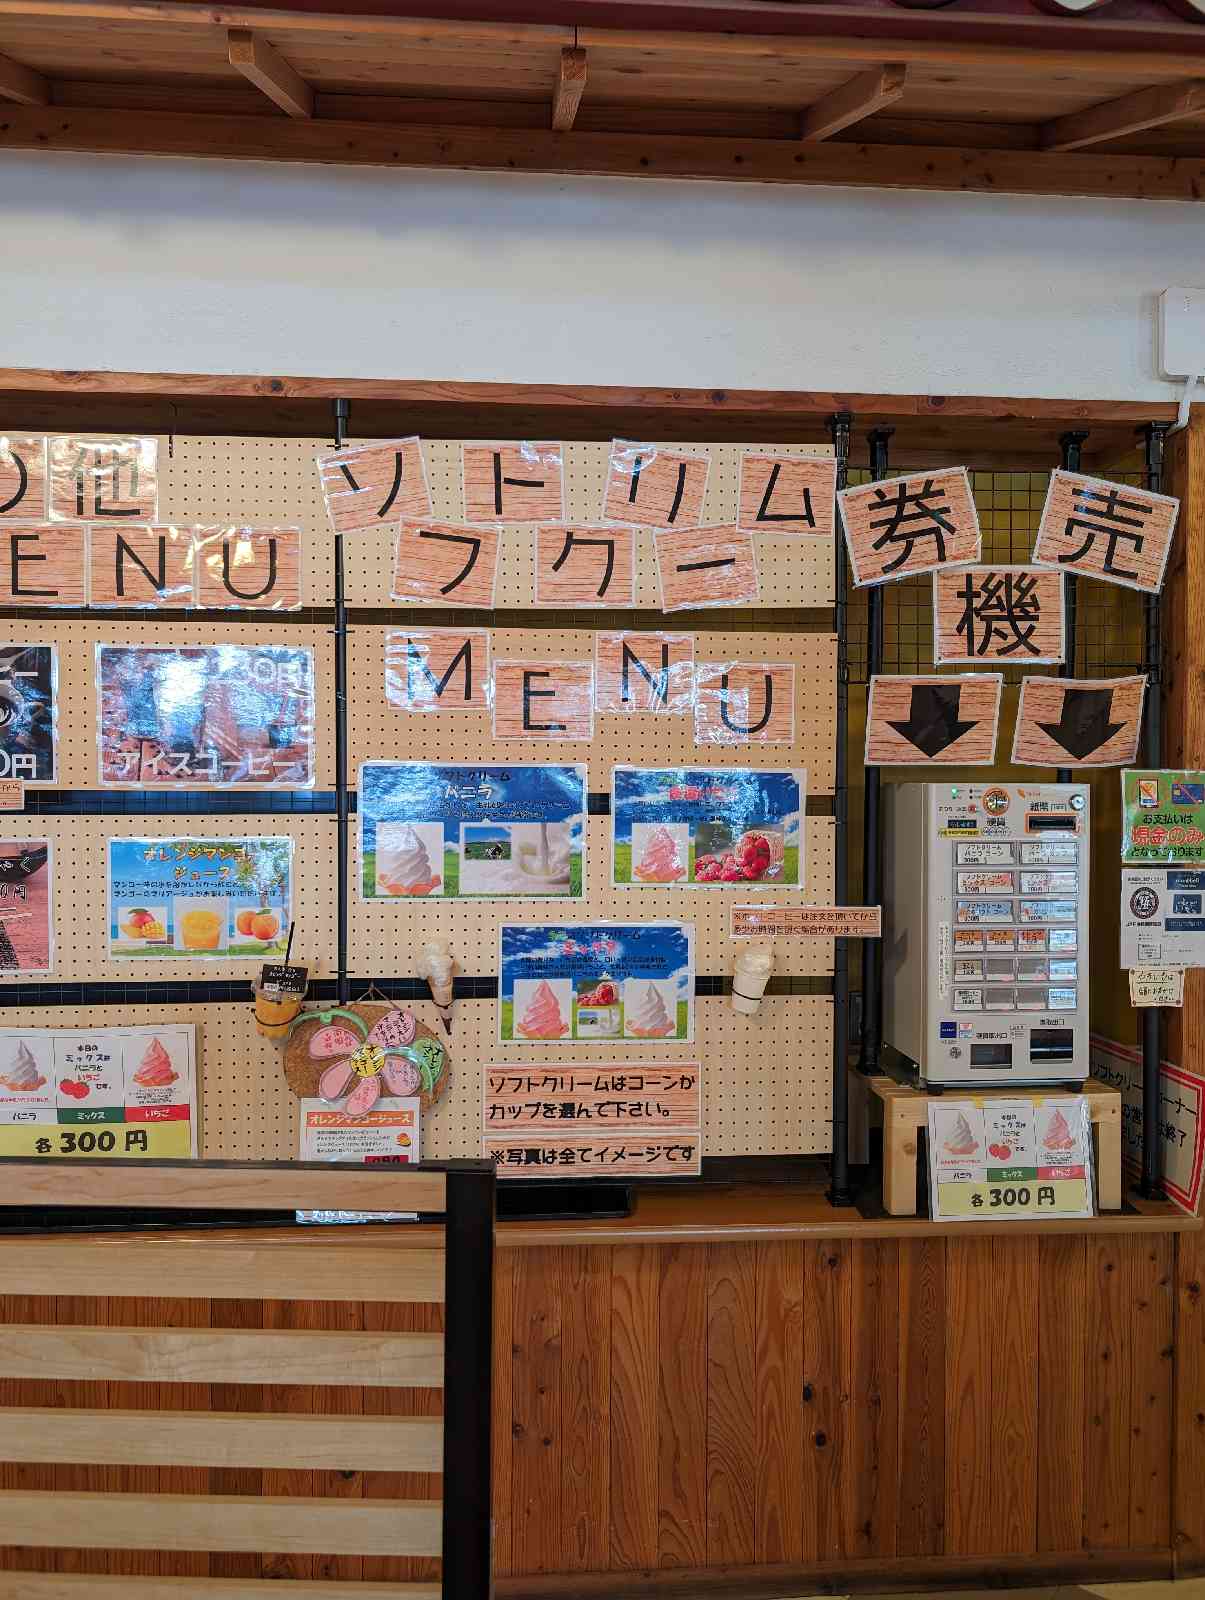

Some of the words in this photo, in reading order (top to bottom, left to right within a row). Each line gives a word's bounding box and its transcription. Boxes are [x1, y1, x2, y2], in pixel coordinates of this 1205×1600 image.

[1143, 814, 1193, 824] お支払いは
[489, 1075, 695, 1093] ソフトクリームはコーンか
[77, 1112, 105, 1120] ミックス
[145, 1109, 170, 1119] いちご
[489, 1102, 670, 1120] カップを選んで下さい。
[13, 1112, 38, 1121] バニラ
[490, 1145, 696, 1166] ※写真は全てイメージです
